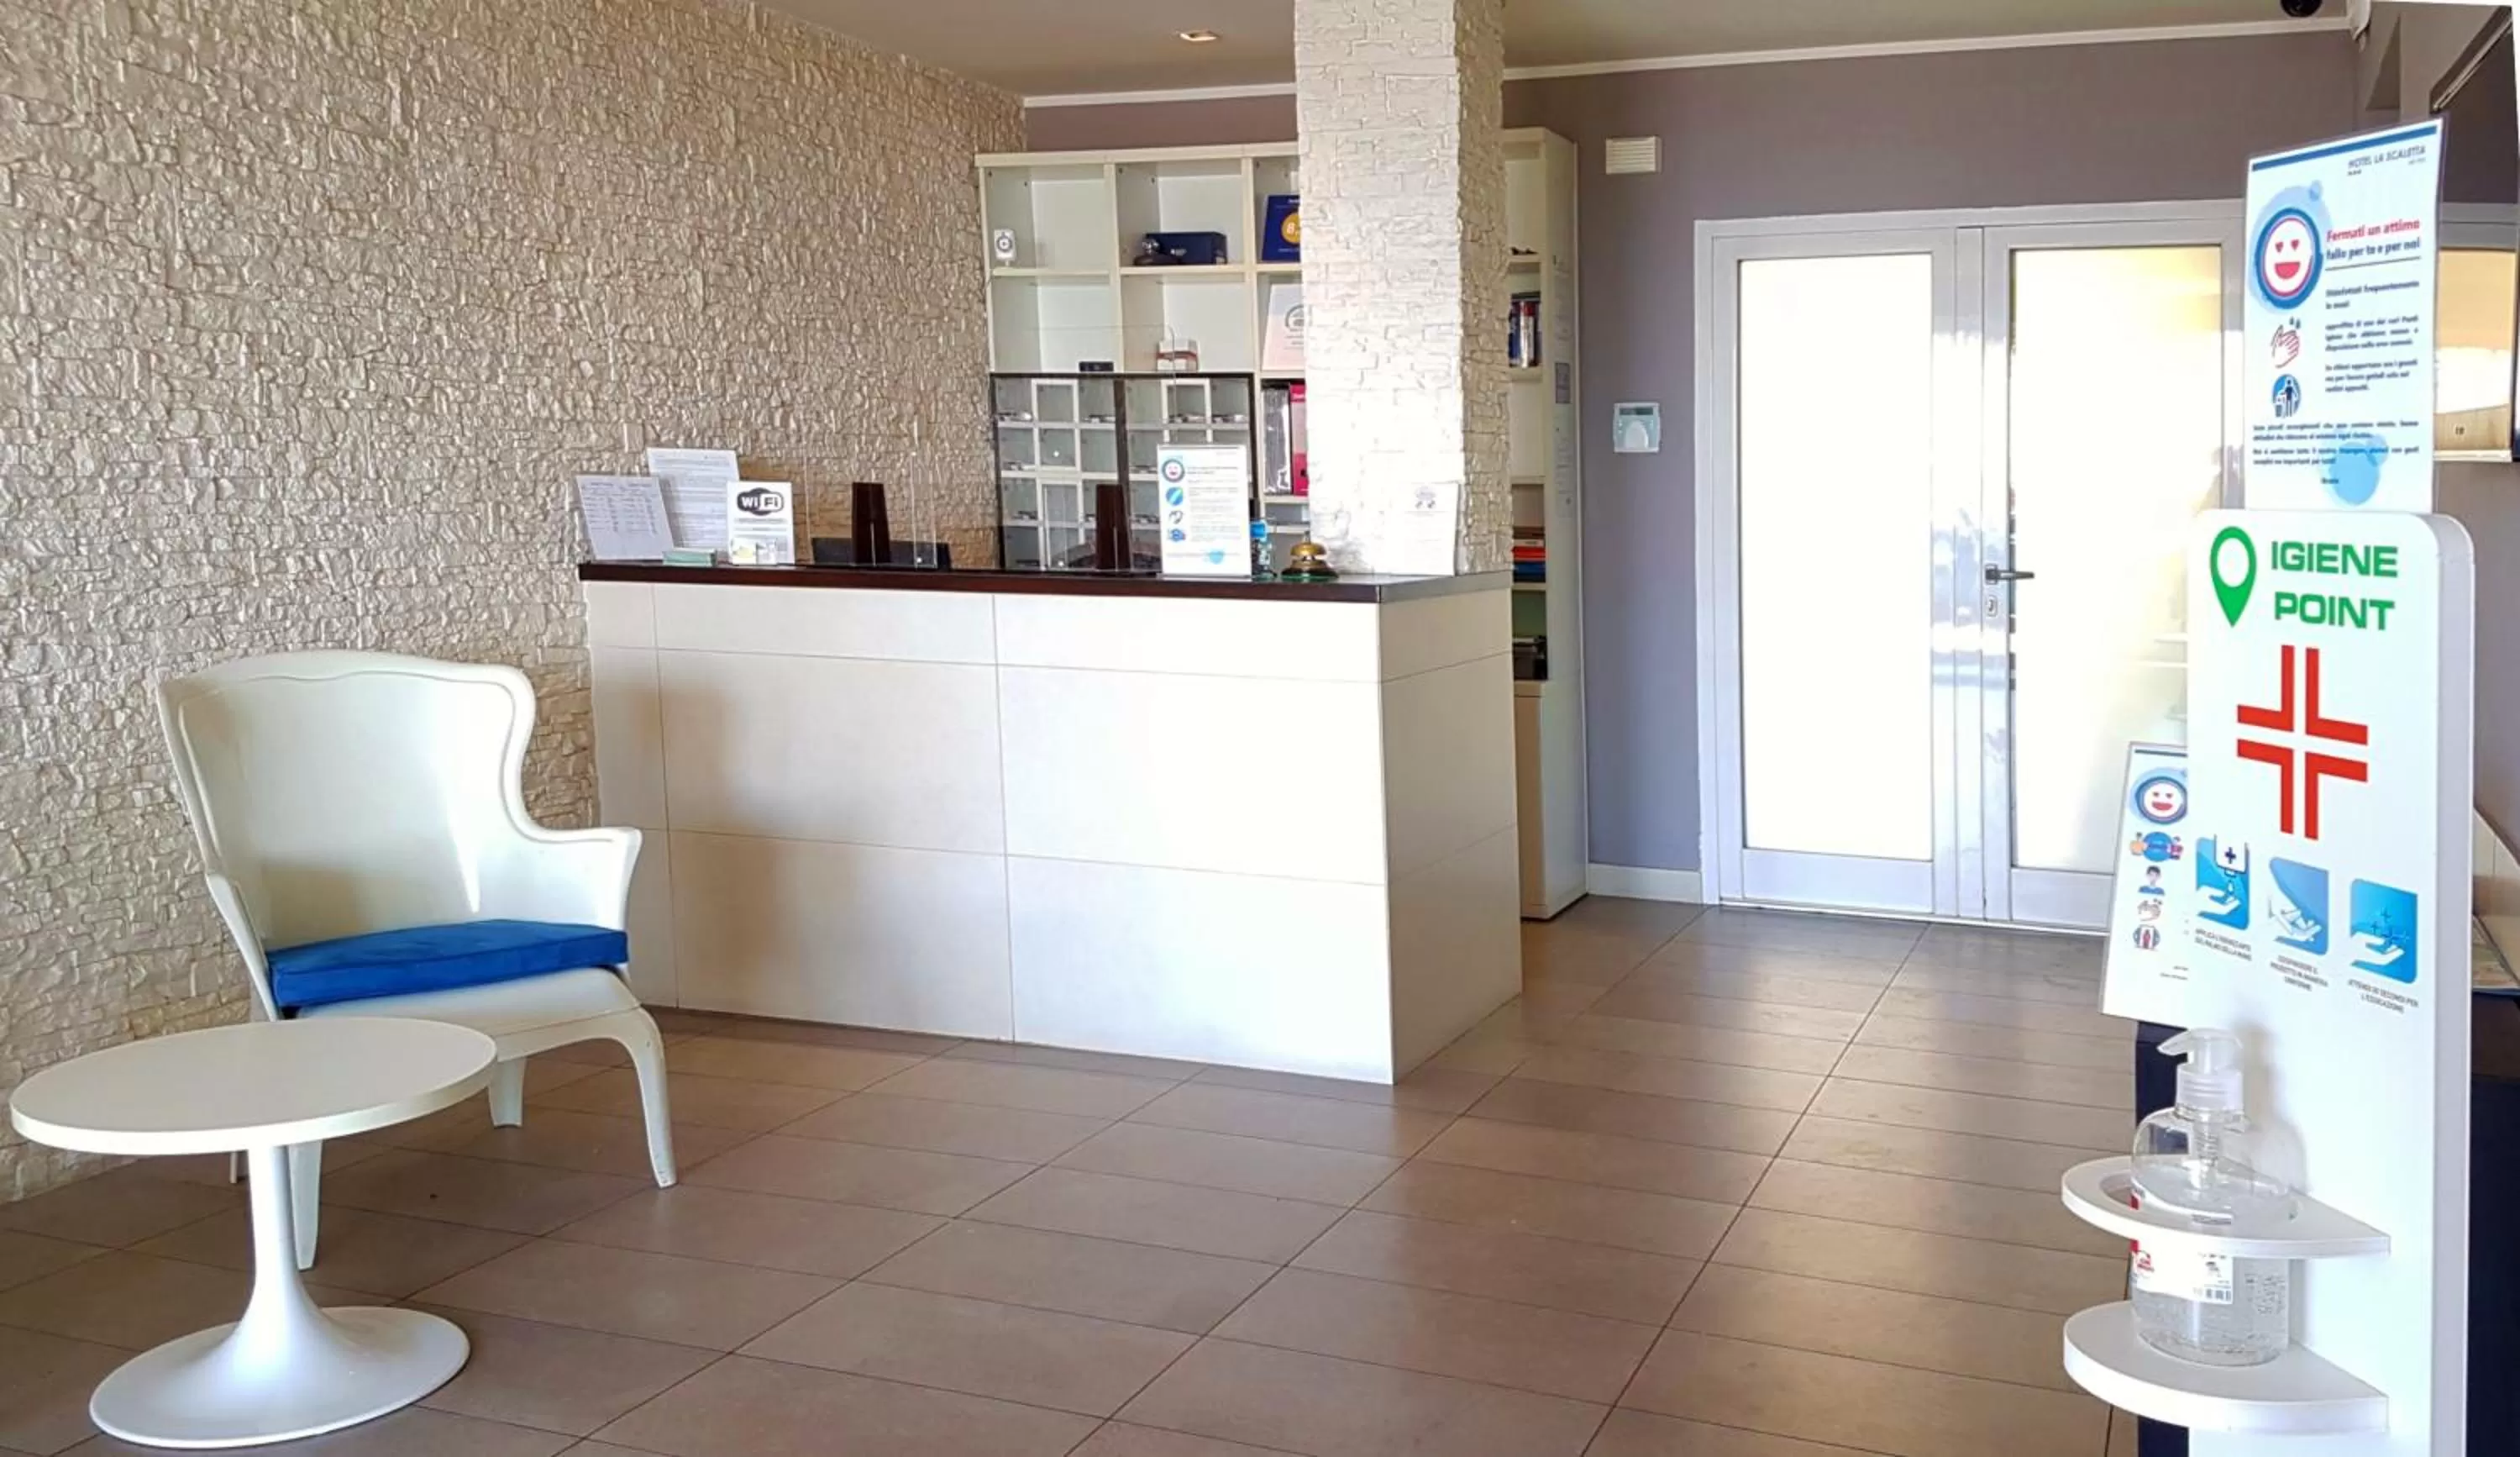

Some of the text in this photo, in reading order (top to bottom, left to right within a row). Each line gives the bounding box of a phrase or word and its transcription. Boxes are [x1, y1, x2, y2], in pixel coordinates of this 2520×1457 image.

[2326, 218, 2420, 243] Fermati un attimo
[2348, 248, 2364, 260] per
[2385, 243, 2402, 255] per
[2271, 540, 2398, 578] IGIENE
[2275, 591, 2396, 631] POINT
